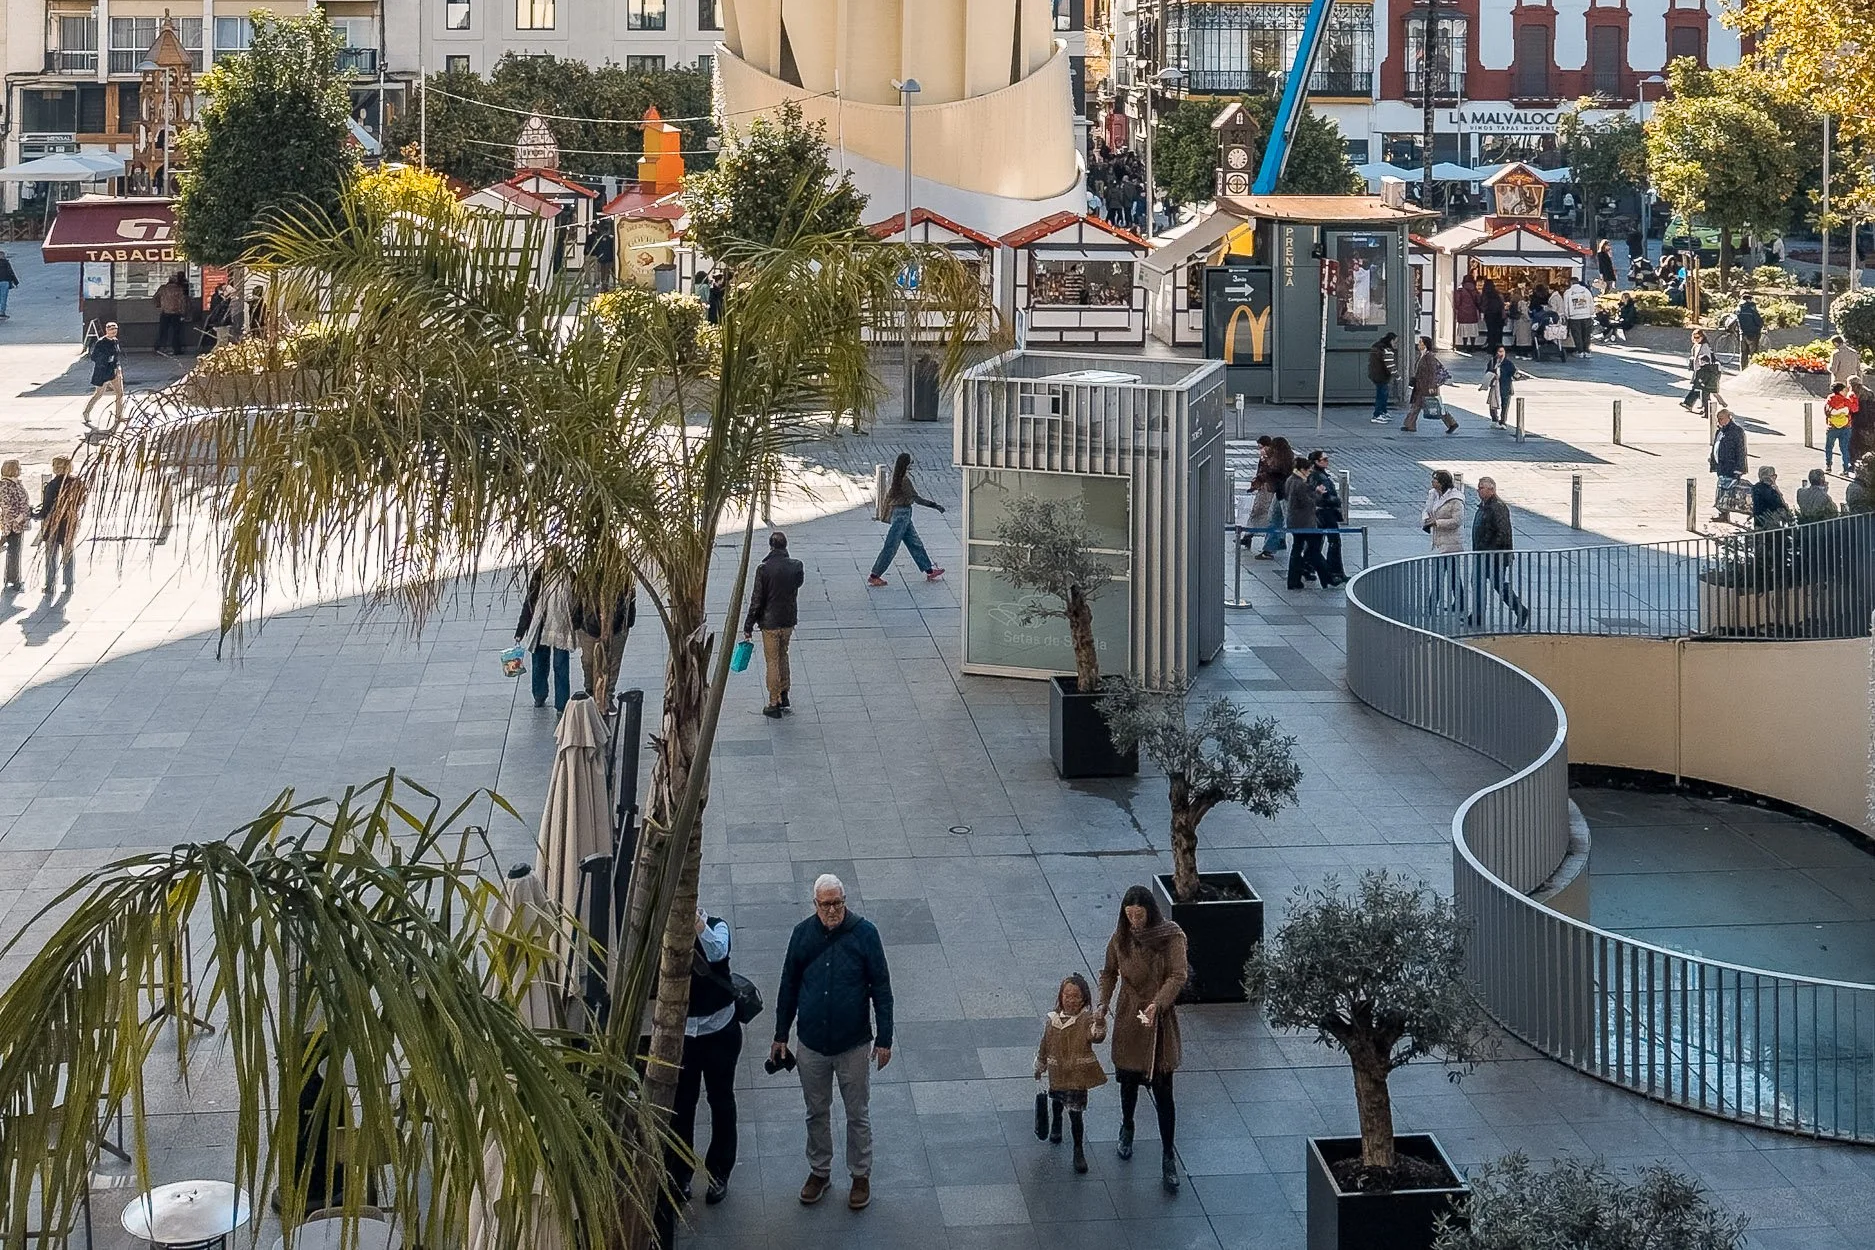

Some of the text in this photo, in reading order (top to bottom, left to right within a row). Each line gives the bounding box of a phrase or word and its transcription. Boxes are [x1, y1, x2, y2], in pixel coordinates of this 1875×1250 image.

[1449, 112, 1467, 124] LA
[86, 248, 176, 262] TABACO
[1285, 227, 1295, 287] PRENSA
[1003, 630, 1040, 645] Setas
[1043, 635, 1060, 647] de
